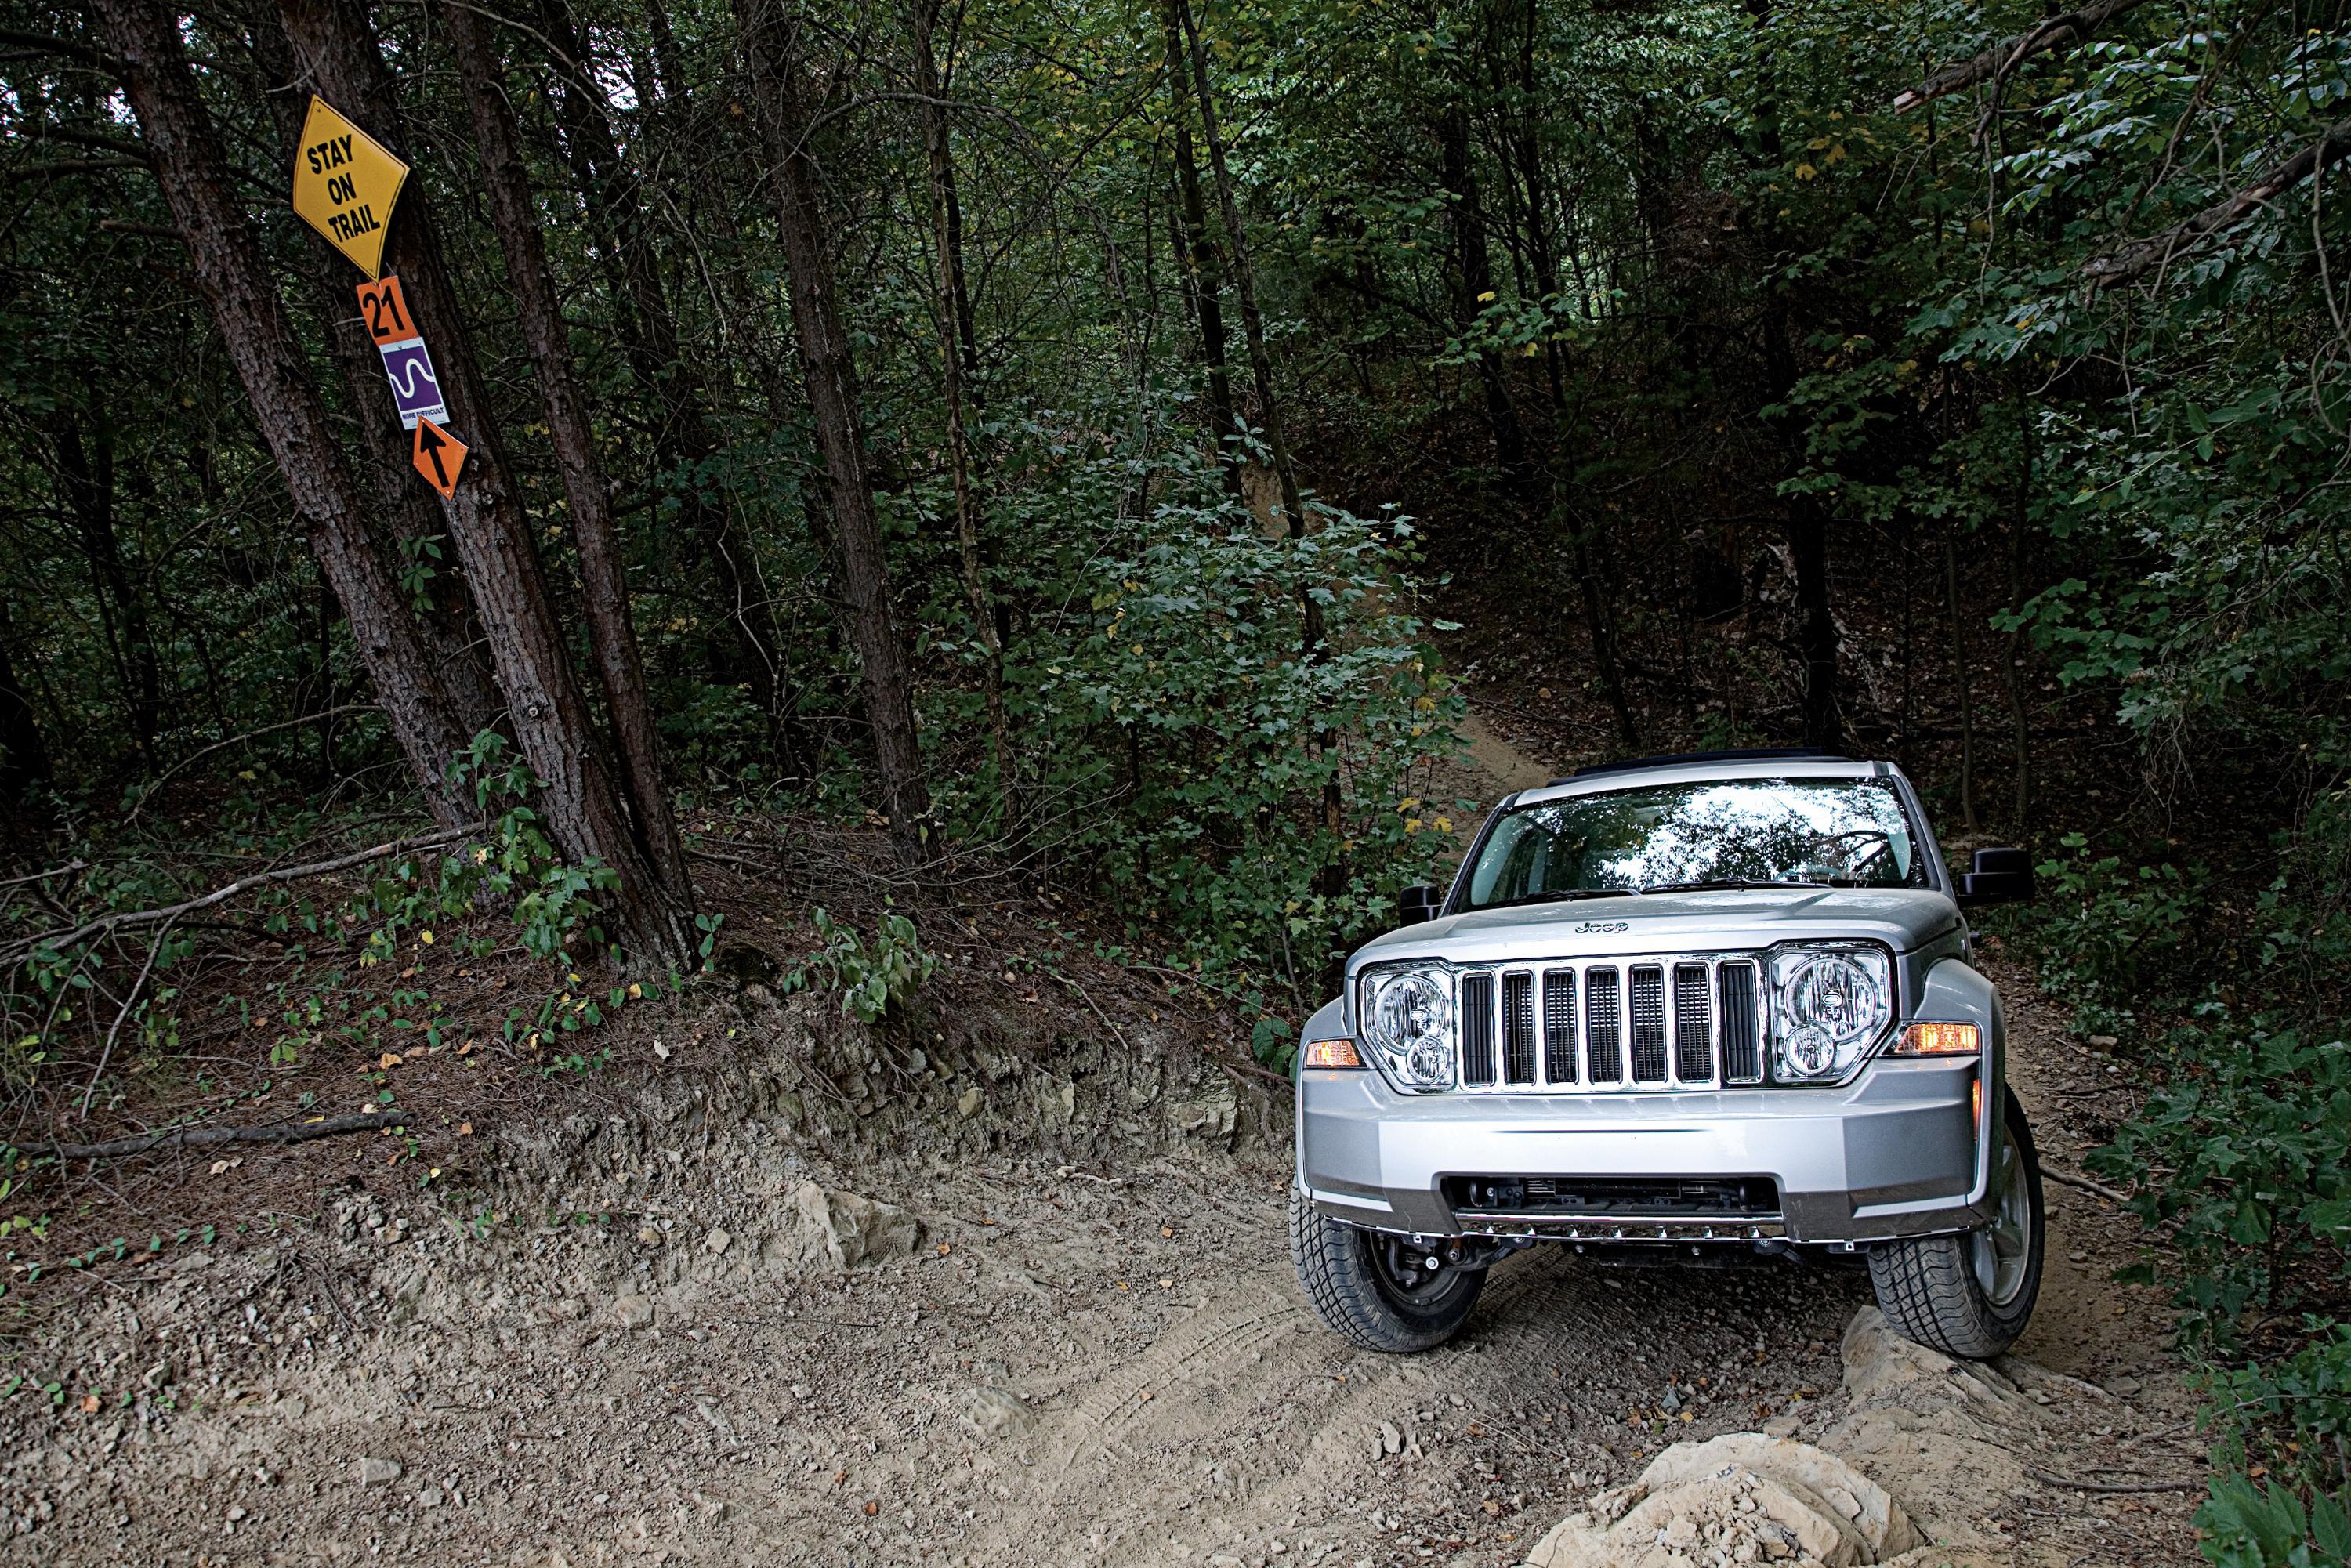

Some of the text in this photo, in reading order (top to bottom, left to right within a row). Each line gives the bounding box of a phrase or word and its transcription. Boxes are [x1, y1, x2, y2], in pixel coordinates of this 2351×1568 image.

[307, 134, 353, 174] STAY
[328, 172, 357, 205] ON
[328, 204, 381, 243] TRAIL
[363, 285, 405, 338] 21
[401, 412, 416, 421] MORE
[1575, 922, 1628, 933] Jeep
